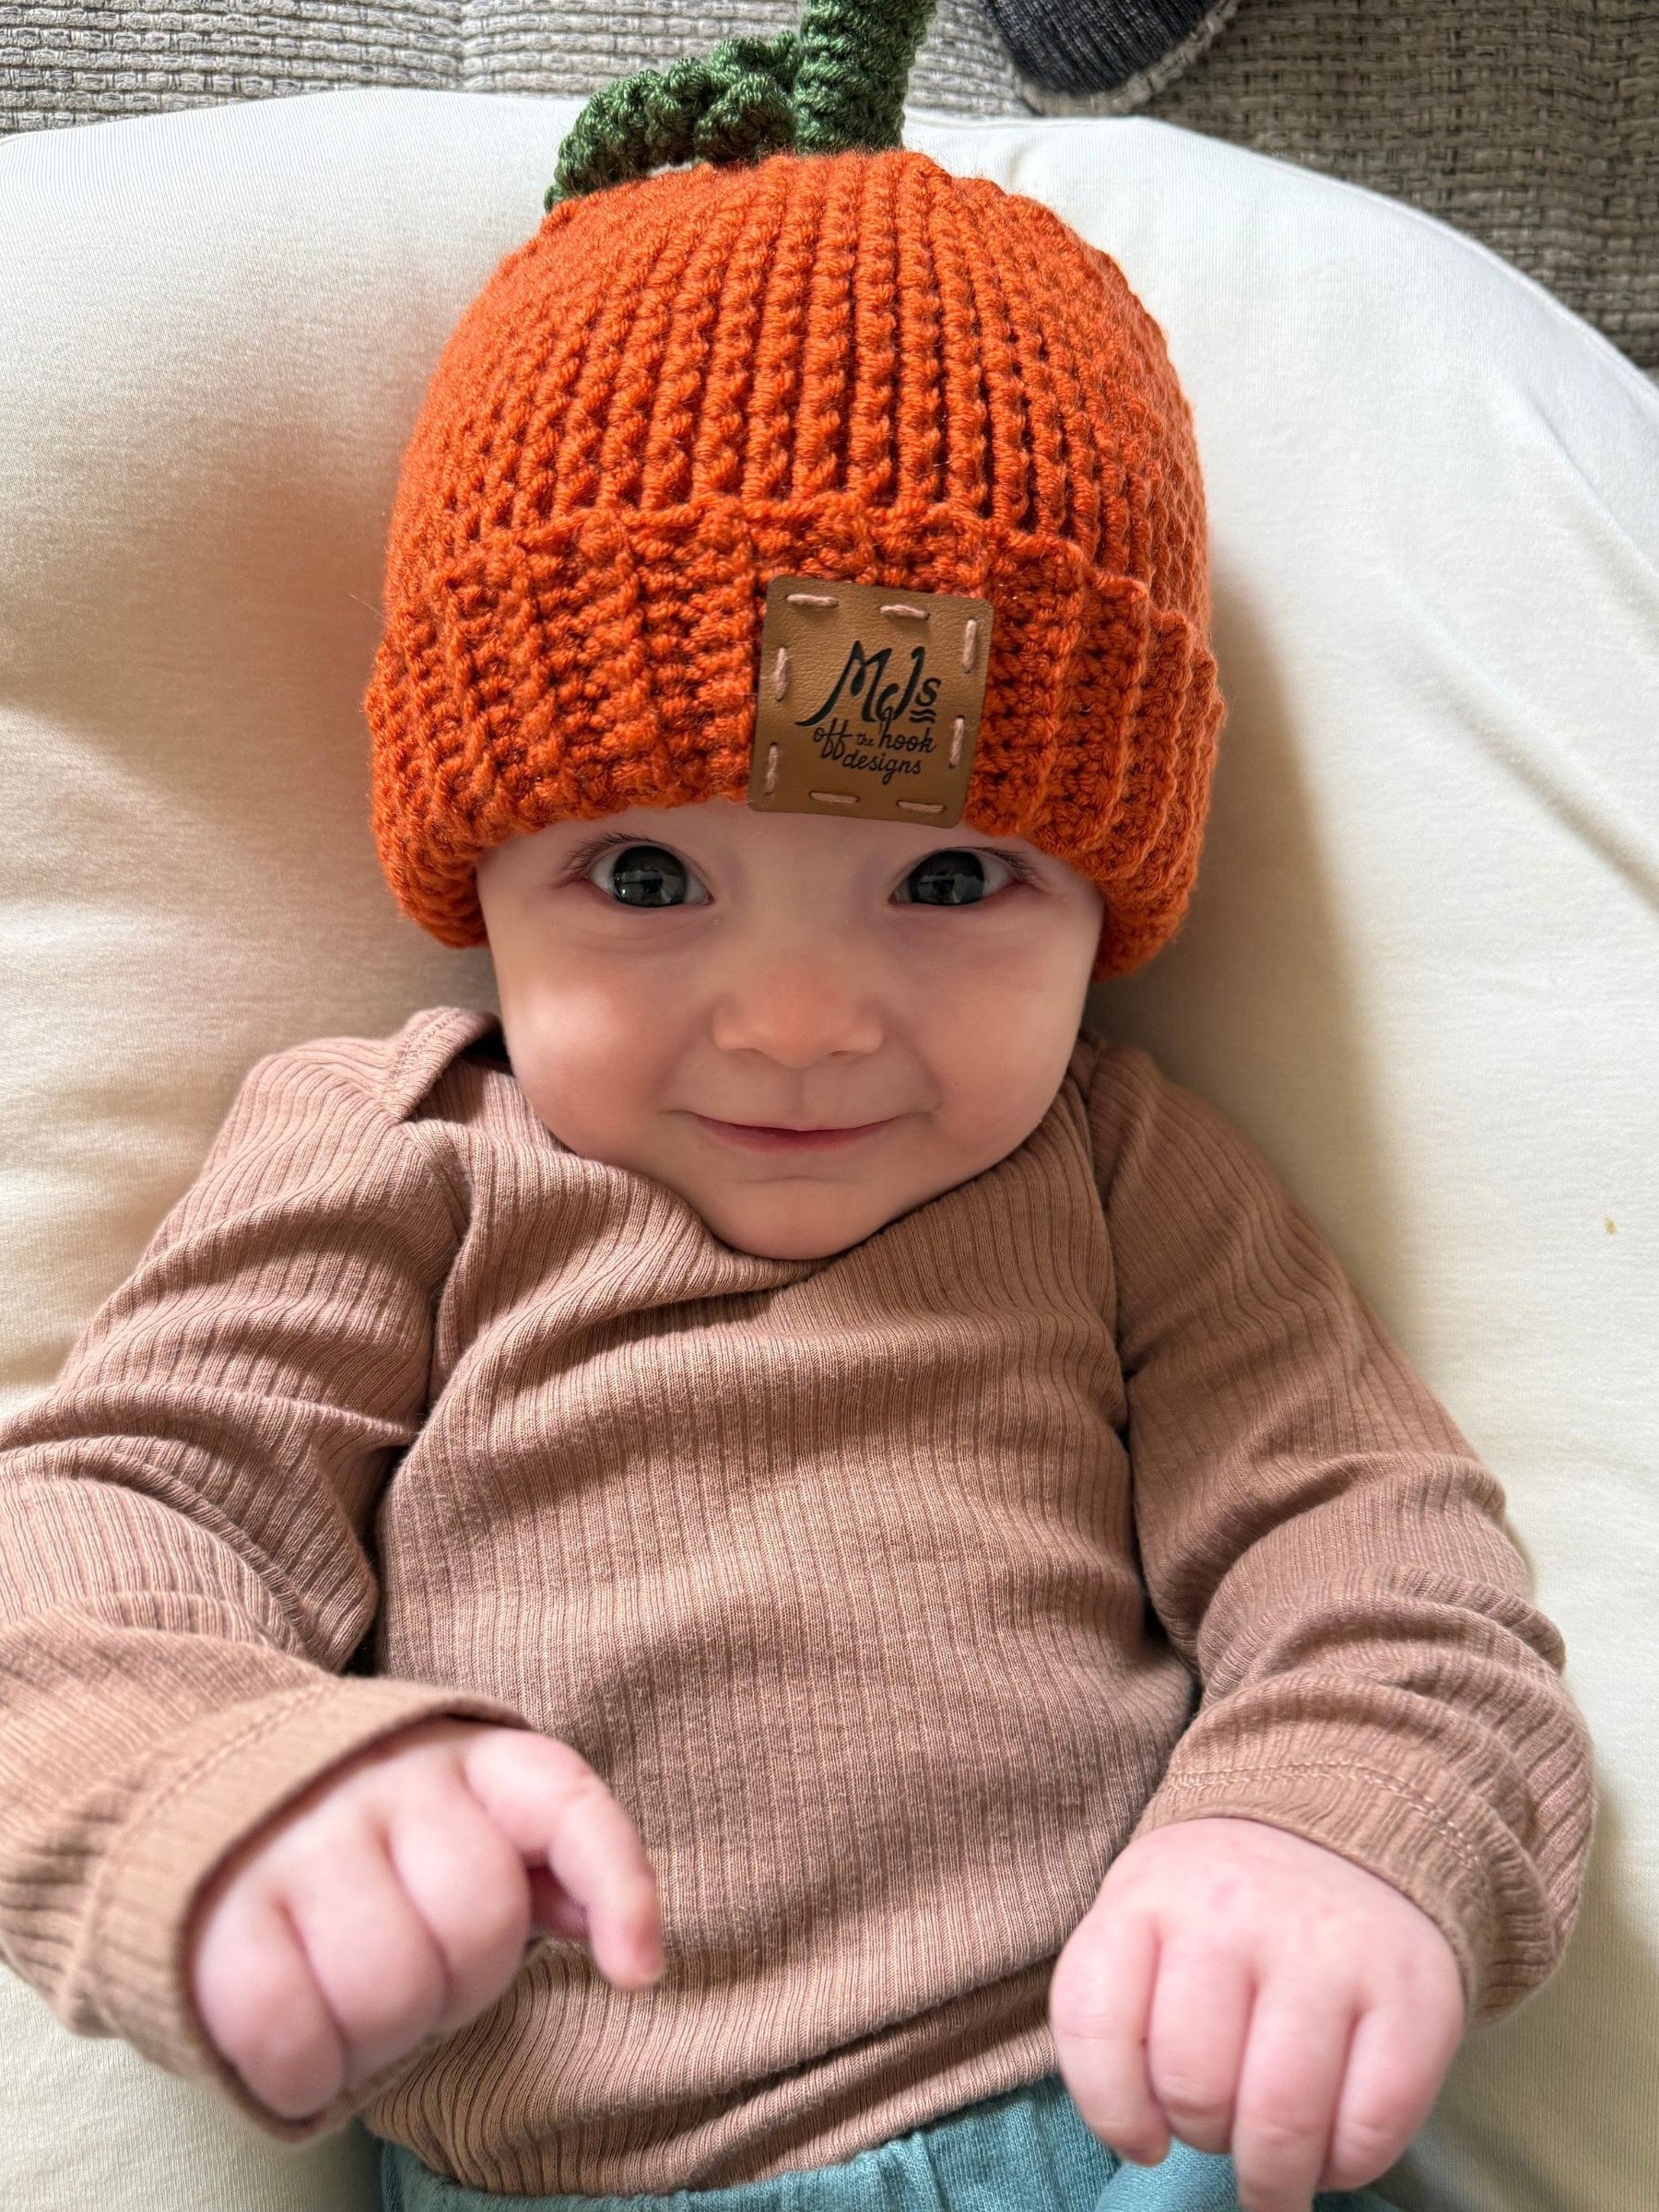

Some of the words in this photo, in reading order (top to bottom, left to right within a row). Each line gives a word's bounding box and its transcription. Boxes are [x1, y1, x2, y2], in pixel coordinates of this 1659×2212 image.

[813, 718, 853, 759] off
[877, 706, 937, 753] hook
[841, 749, 922, 784] designs
